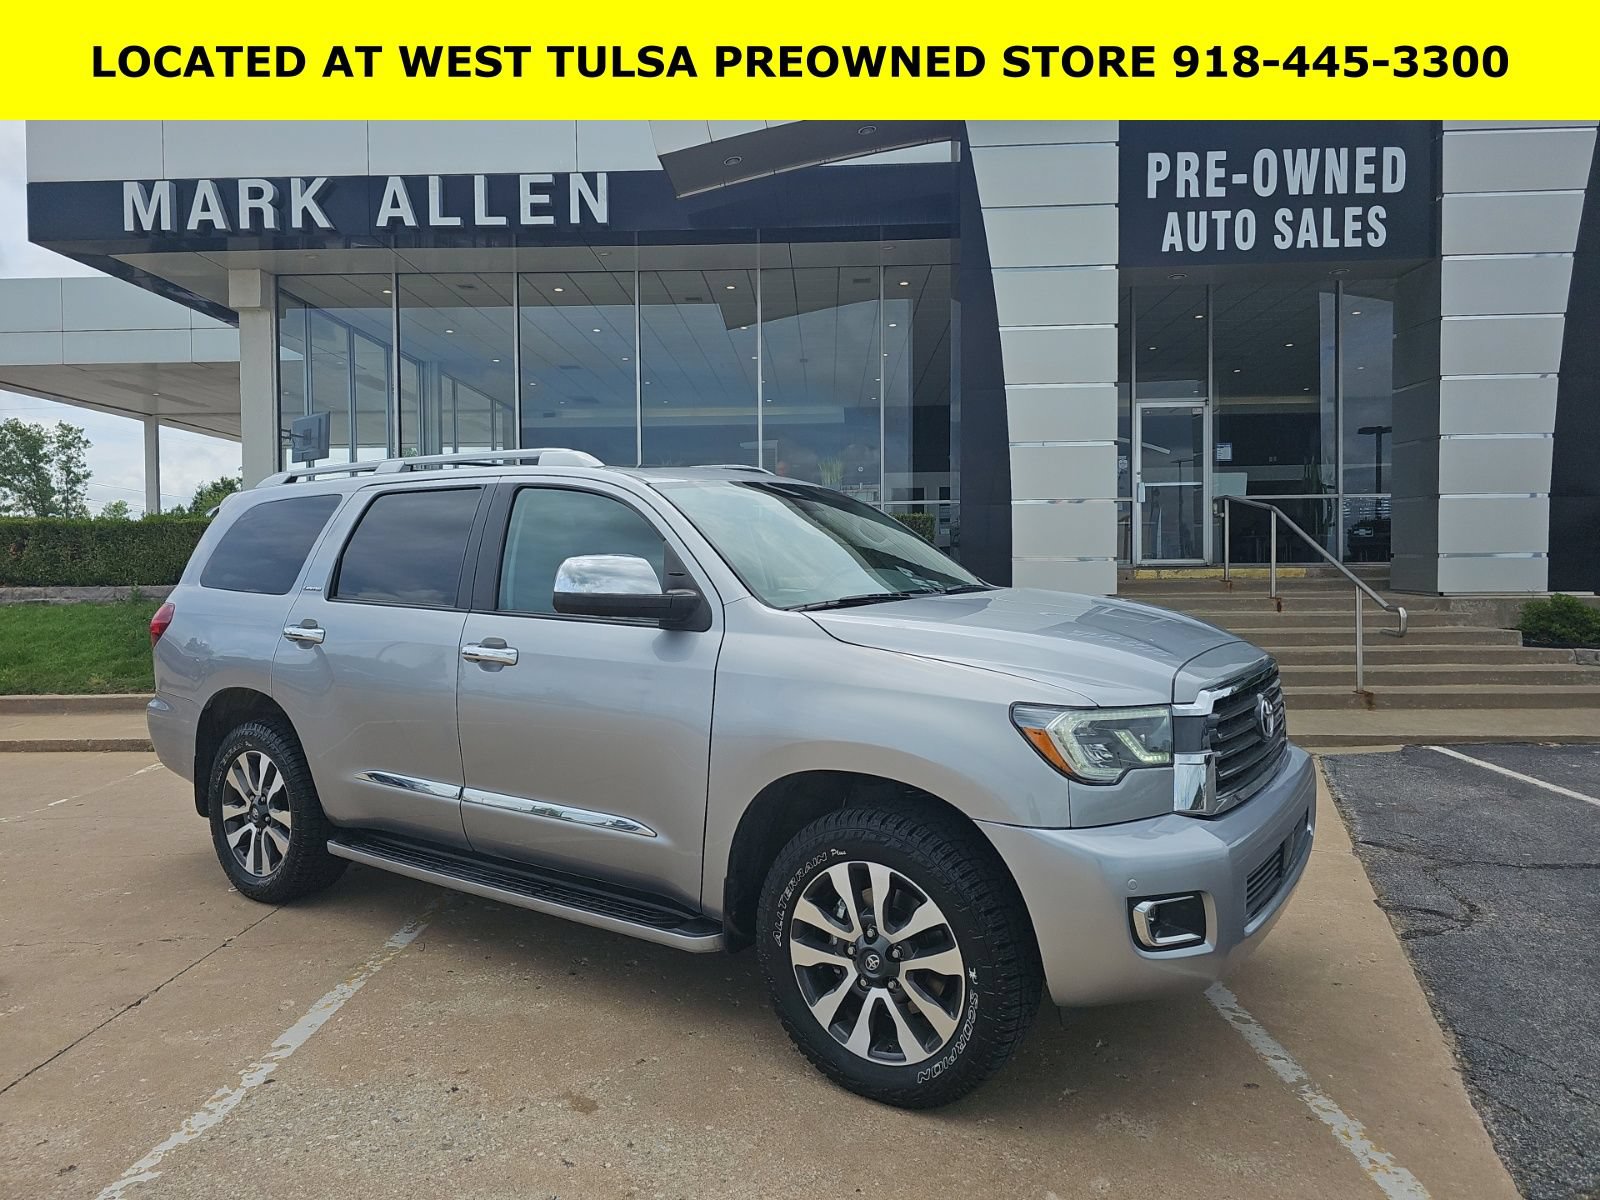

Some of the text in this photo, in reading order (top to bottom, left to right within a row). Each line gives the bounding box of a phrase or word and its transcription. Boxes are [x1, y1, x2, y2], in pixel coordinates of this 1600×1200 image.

[1147, 146, 1407, 199] PRE-OWNED
[122, 172, 610, 233] MARK ALLEN
[1161, 205, 1387, 252] AUTO SALES
[917, 989, 979, 1084] SCORPION
